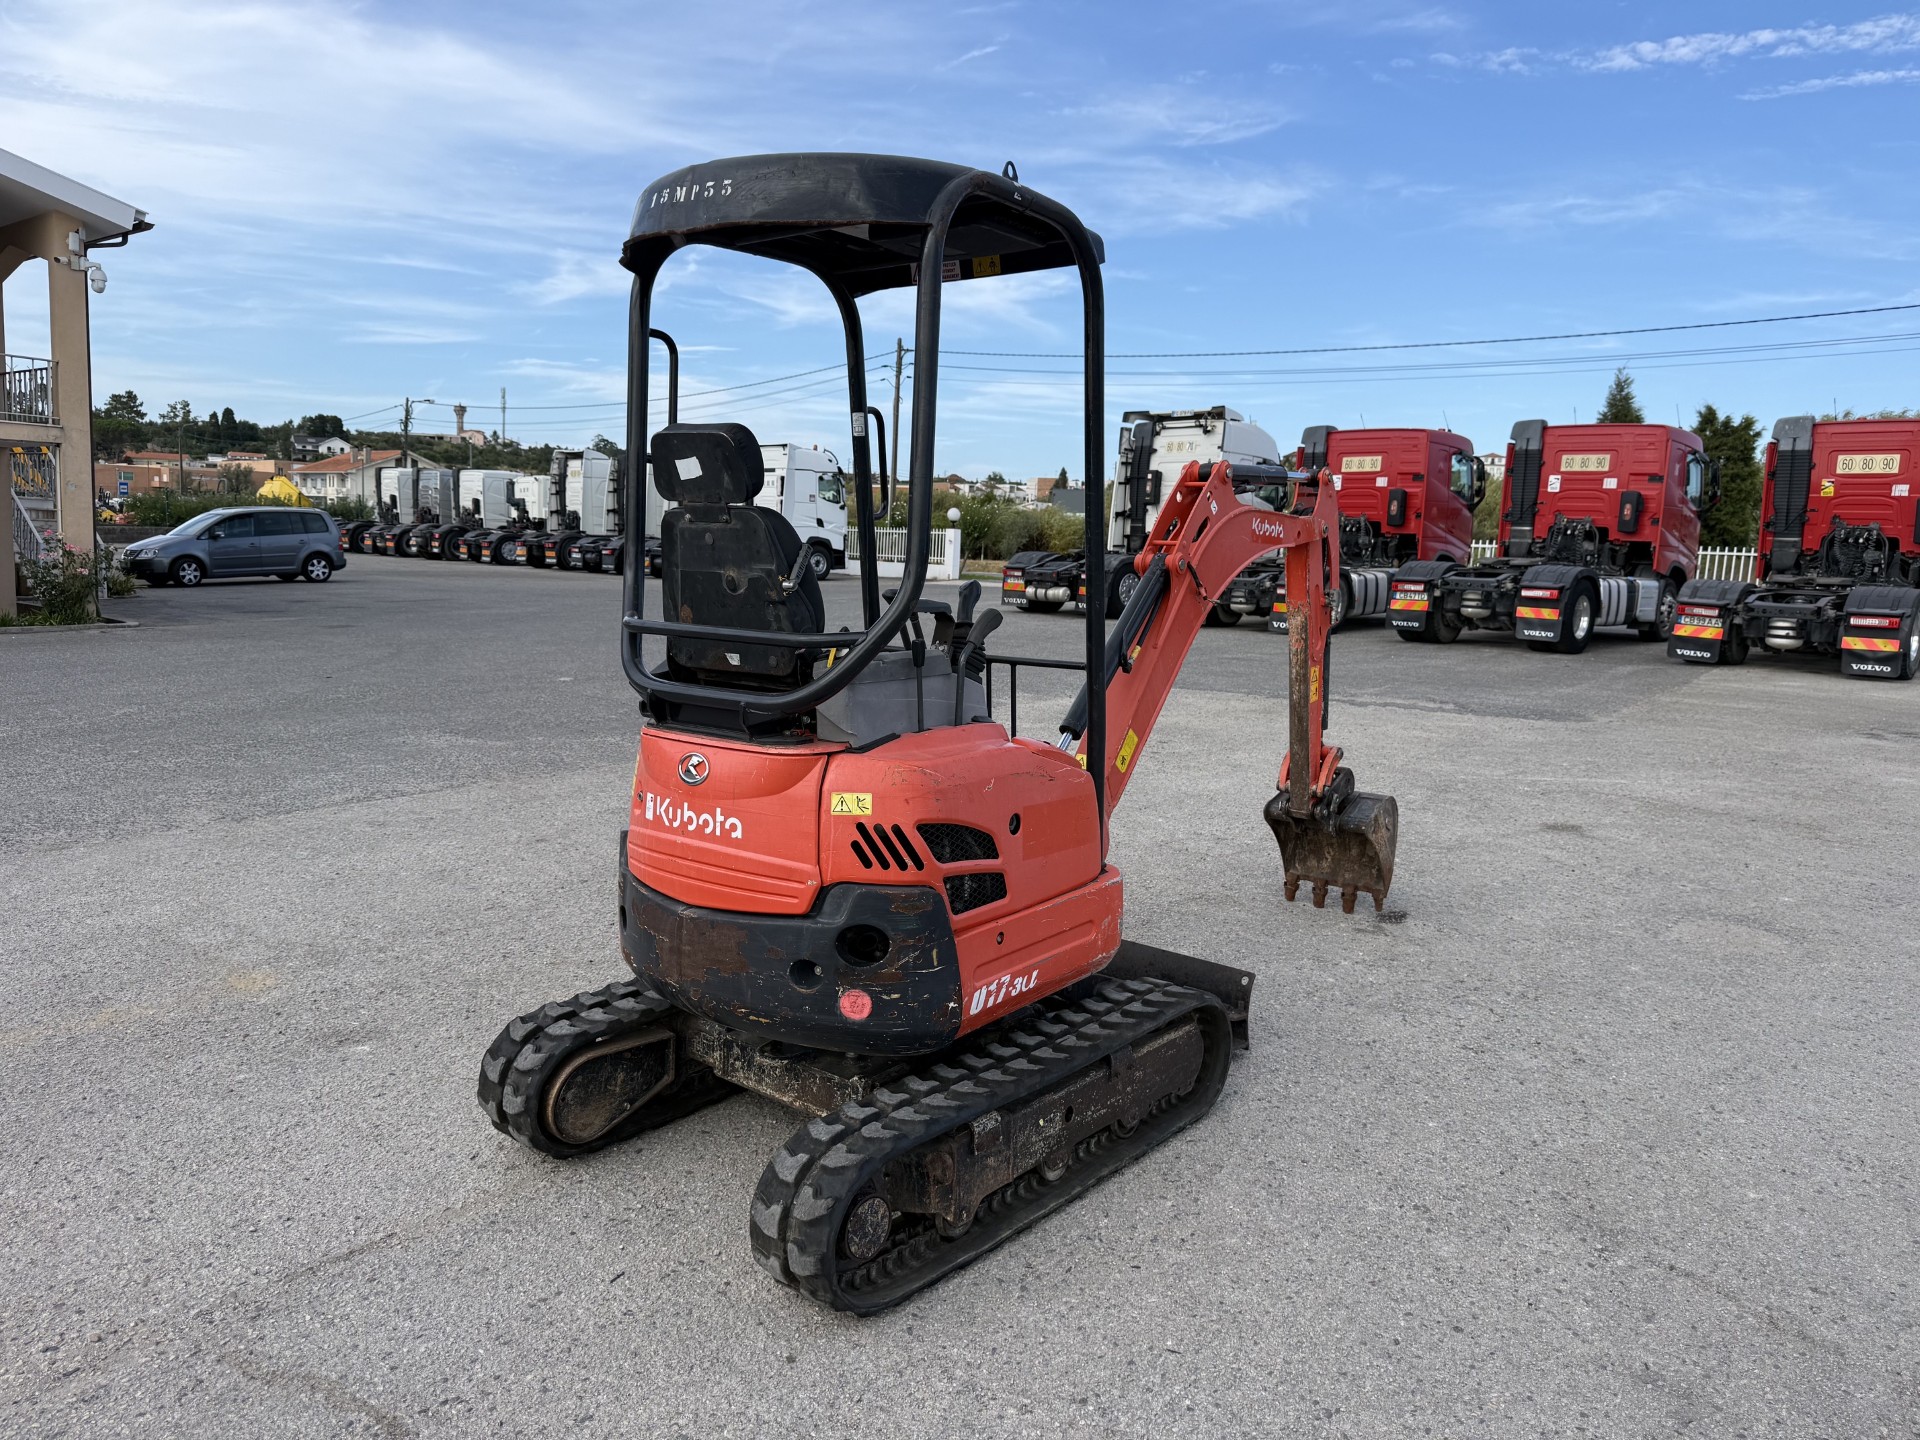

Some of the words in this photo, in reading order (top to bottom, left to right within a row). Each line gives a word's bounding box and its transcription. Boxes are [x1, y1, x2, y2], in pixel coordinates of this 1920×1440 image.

[1344, 459, 1353, 470] 60
[1357, 459, 1366, 470] 80
[1370, 458, 1379, 469] 90
[1564, 457, 1575, 469] 60
[1580, 457, 1590, 469] 80
[1595, 457, 1606, 469] 90
[1841, 458, 1854, 471] 60
[1861, 458, 1874, 471] 80
[1882, 457, 1895, 470] 90
[1252, 517, 1284, 538] Kubota
[1391, 620, 1420, 628] VOLVO
[1523, 629, 1555, 638] VOLVO
[1675, 648, 1711, 658] VOLVO
[1850, 663, 1892, 672] VOLVO
[656, 795, 743, 839] Kubota
